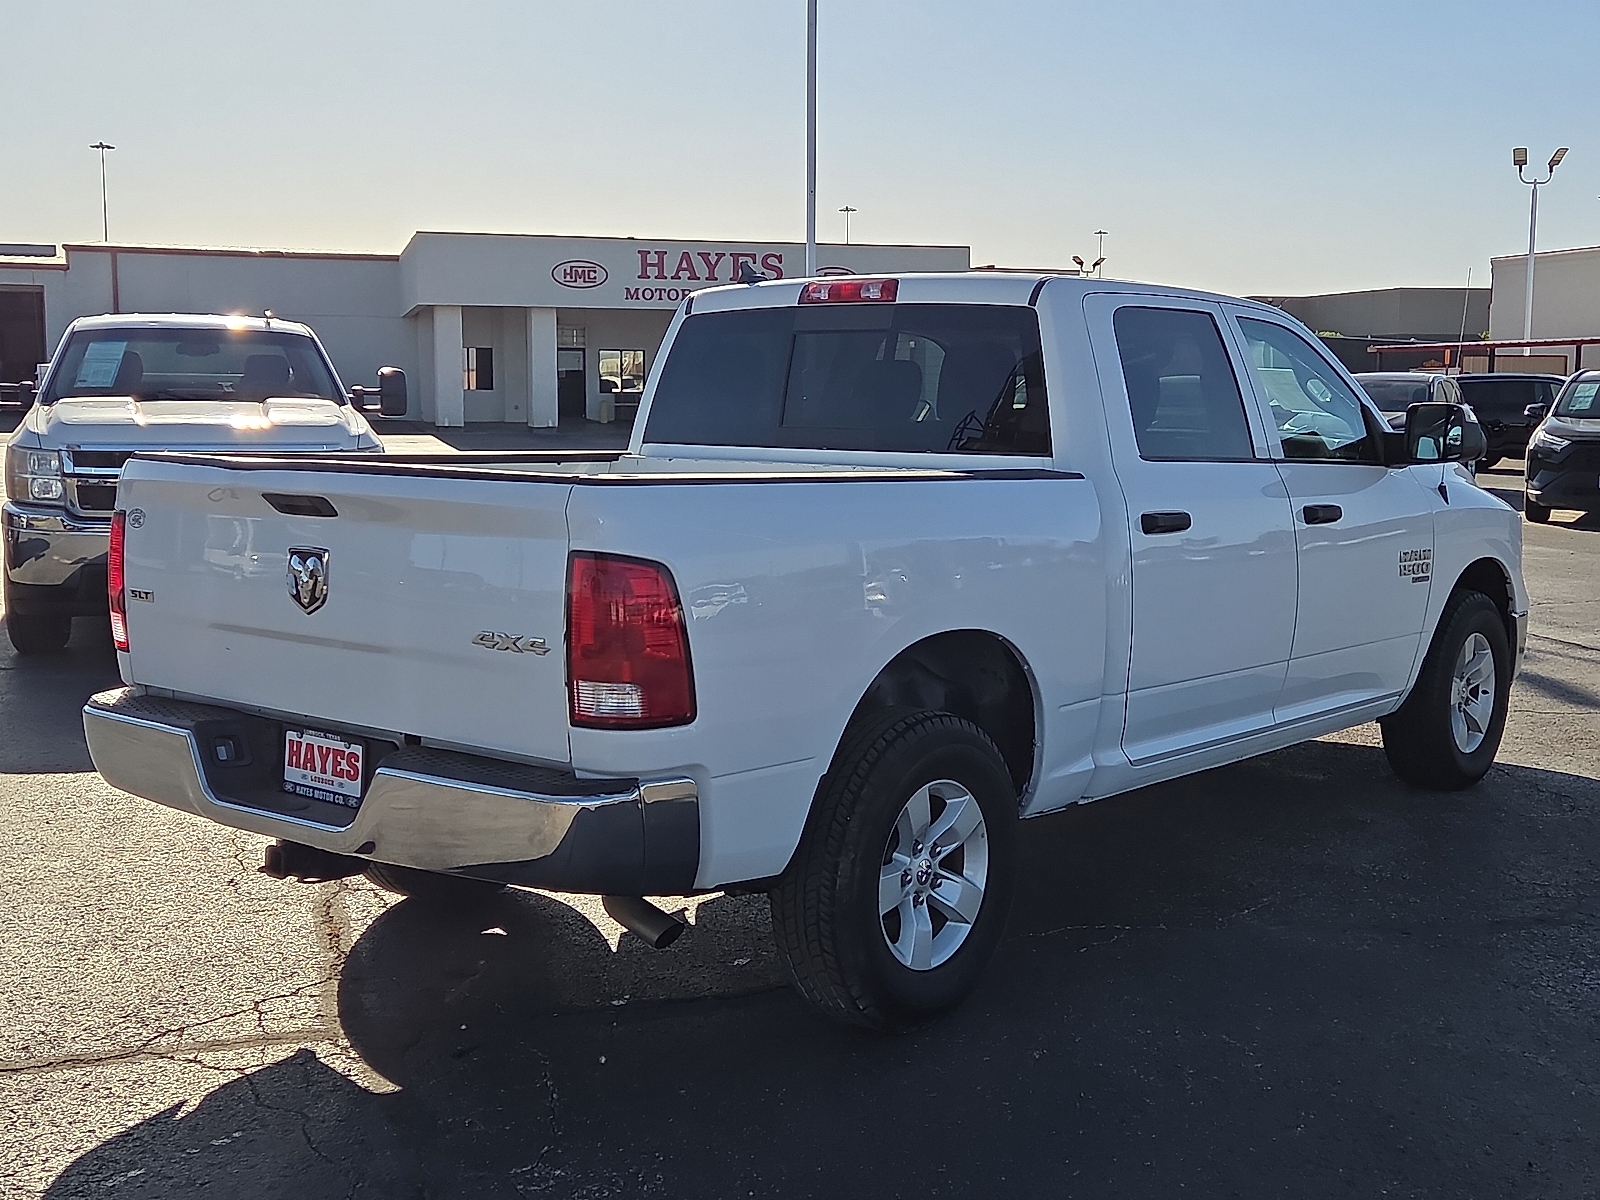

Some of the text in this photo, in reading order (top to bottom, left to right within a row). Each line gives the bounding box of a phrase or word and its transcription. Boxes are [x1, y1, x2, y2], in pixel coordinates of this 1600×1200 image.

[563, 265, 598, 283] HMC
[637, 249, 784, 283] HAYES
[130, 589, 151, 600] SLT
[287, 738, 361, 782] HAYES
[295, 785, 314, 797] HAYES
[314, 789, 334, 803] MOTOR
